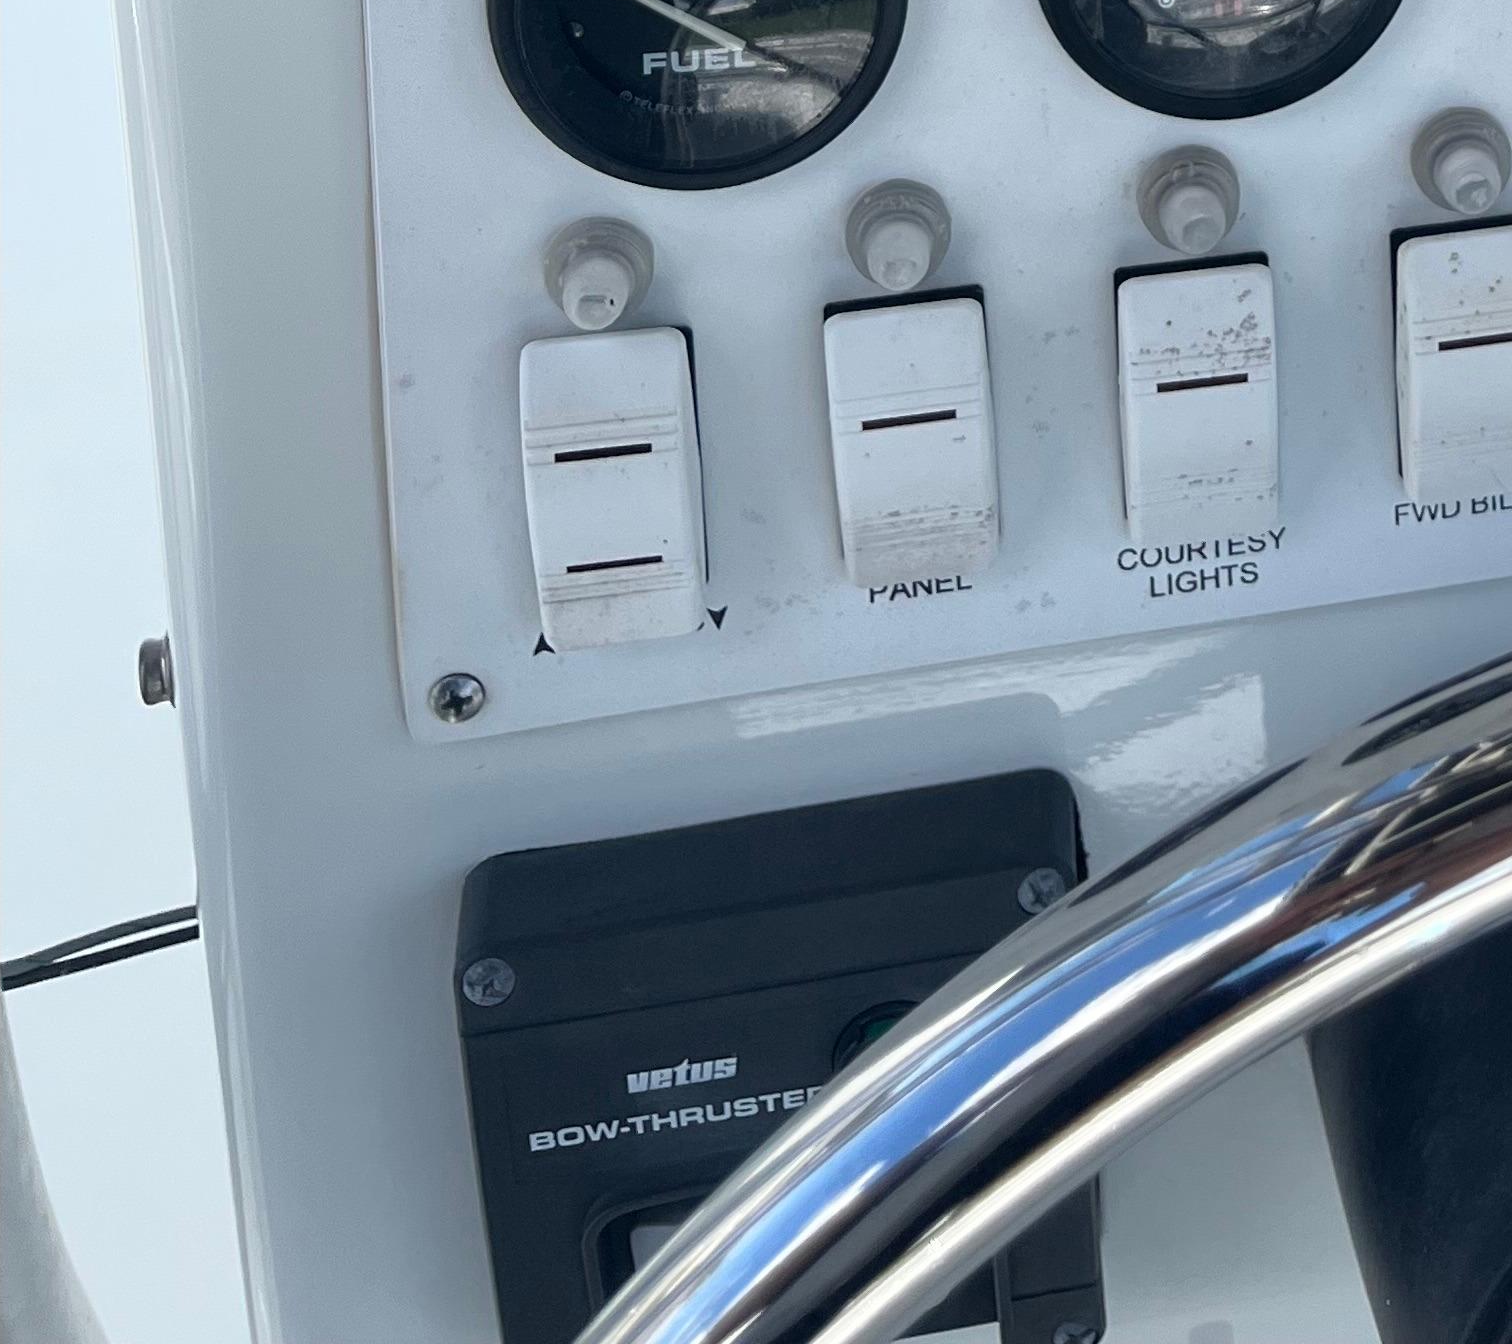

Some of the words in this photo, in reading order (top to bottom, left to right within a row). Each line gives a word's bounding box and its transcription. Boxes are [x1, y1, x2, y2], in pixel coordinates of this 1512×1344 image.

[643, 46, 758, 75] FUEL
[1394, 500, 1461, 526] FWD
[1117, 526, 1287, 571] COURTESY
[869, 575, 973, 604] PANEL
[1149, 562, 1260, 598] LIGHTS
[626, 1056, 738, 1095] vetus
